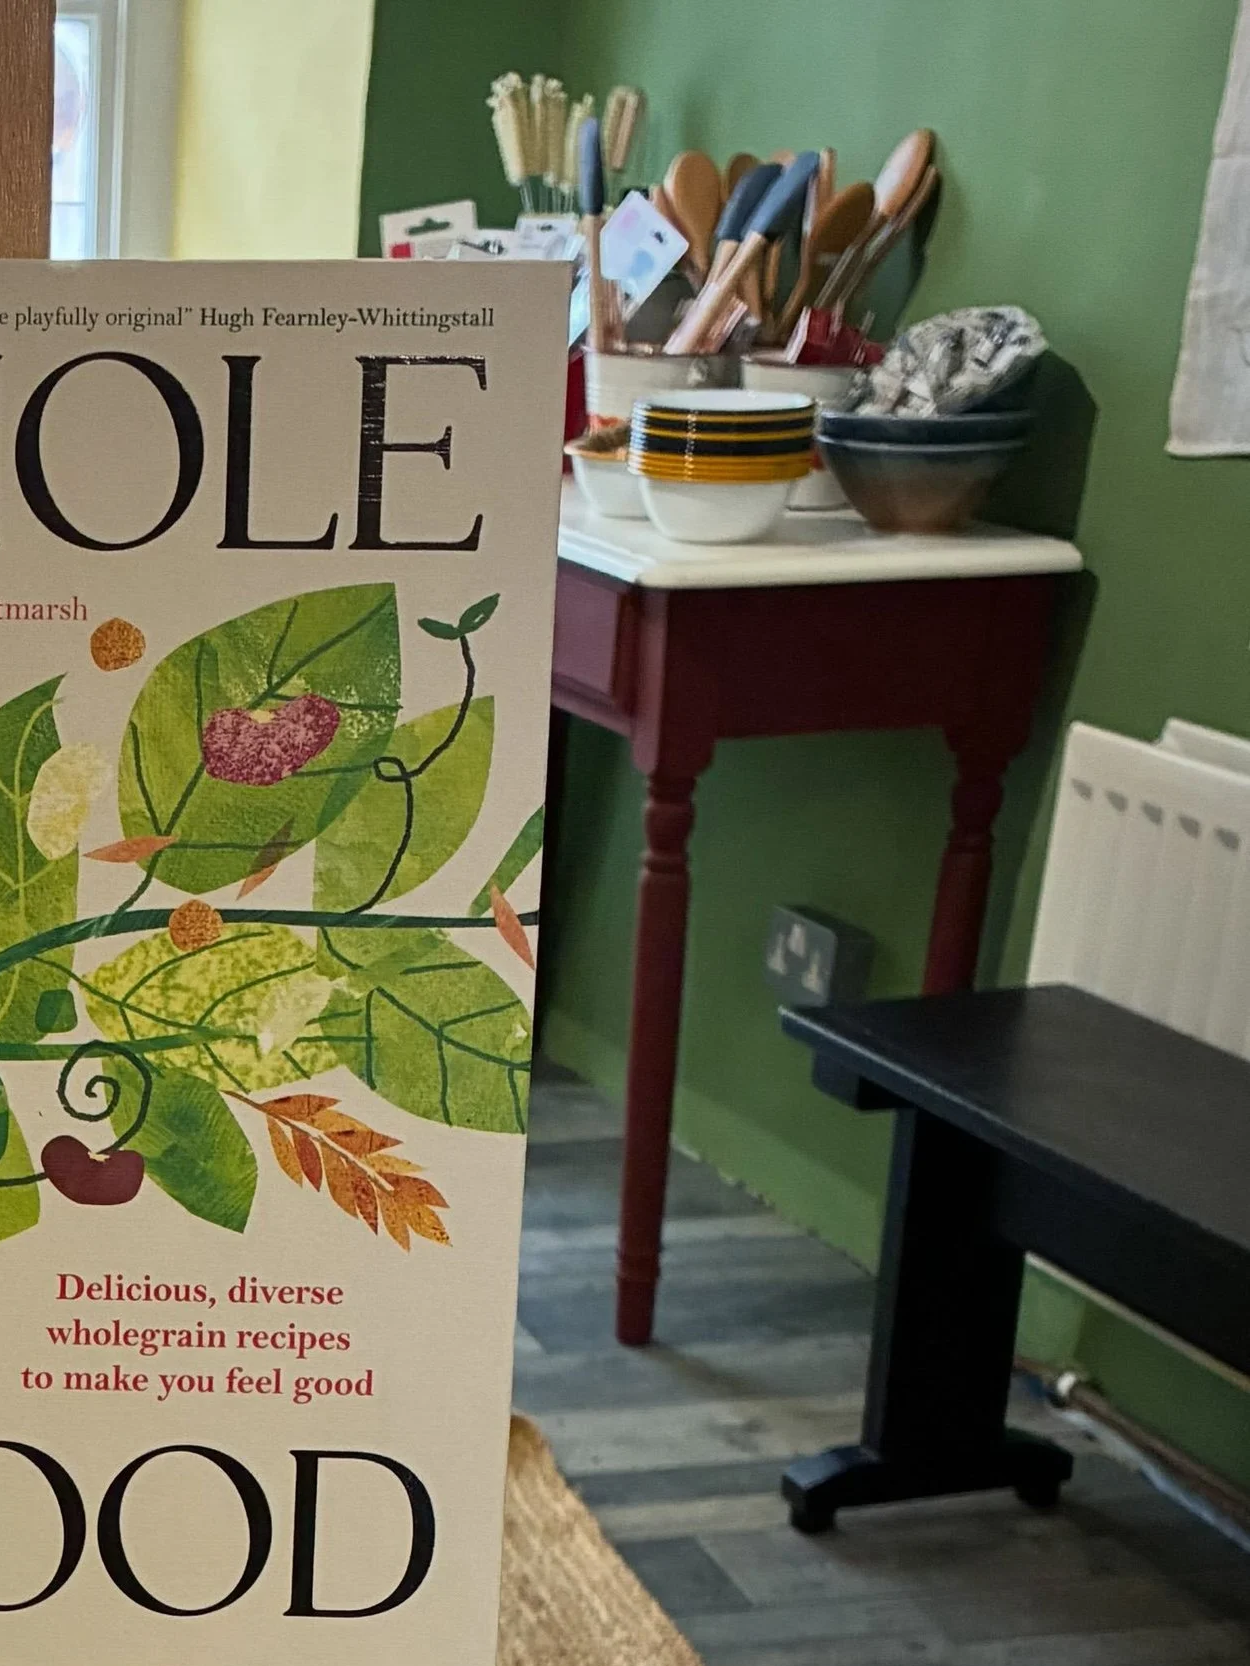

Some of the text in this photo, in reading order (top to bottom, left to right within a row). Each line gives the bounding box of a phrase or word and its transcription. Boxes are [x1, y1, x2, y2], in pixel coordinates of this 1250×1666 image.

[15, 306, 100, 333] playfully
[106, 307, 193, 333] original”
[200, 307, 254, 333] Hugh
[261, 307, 495, 334] Fearnley-Whittingstall
[56, 1272, 344, 1309] Delicious, diverse
[46, 1318, 351, 1360] wholegrain recipes
[21, 1364, 374, 1405] to make you feel good
